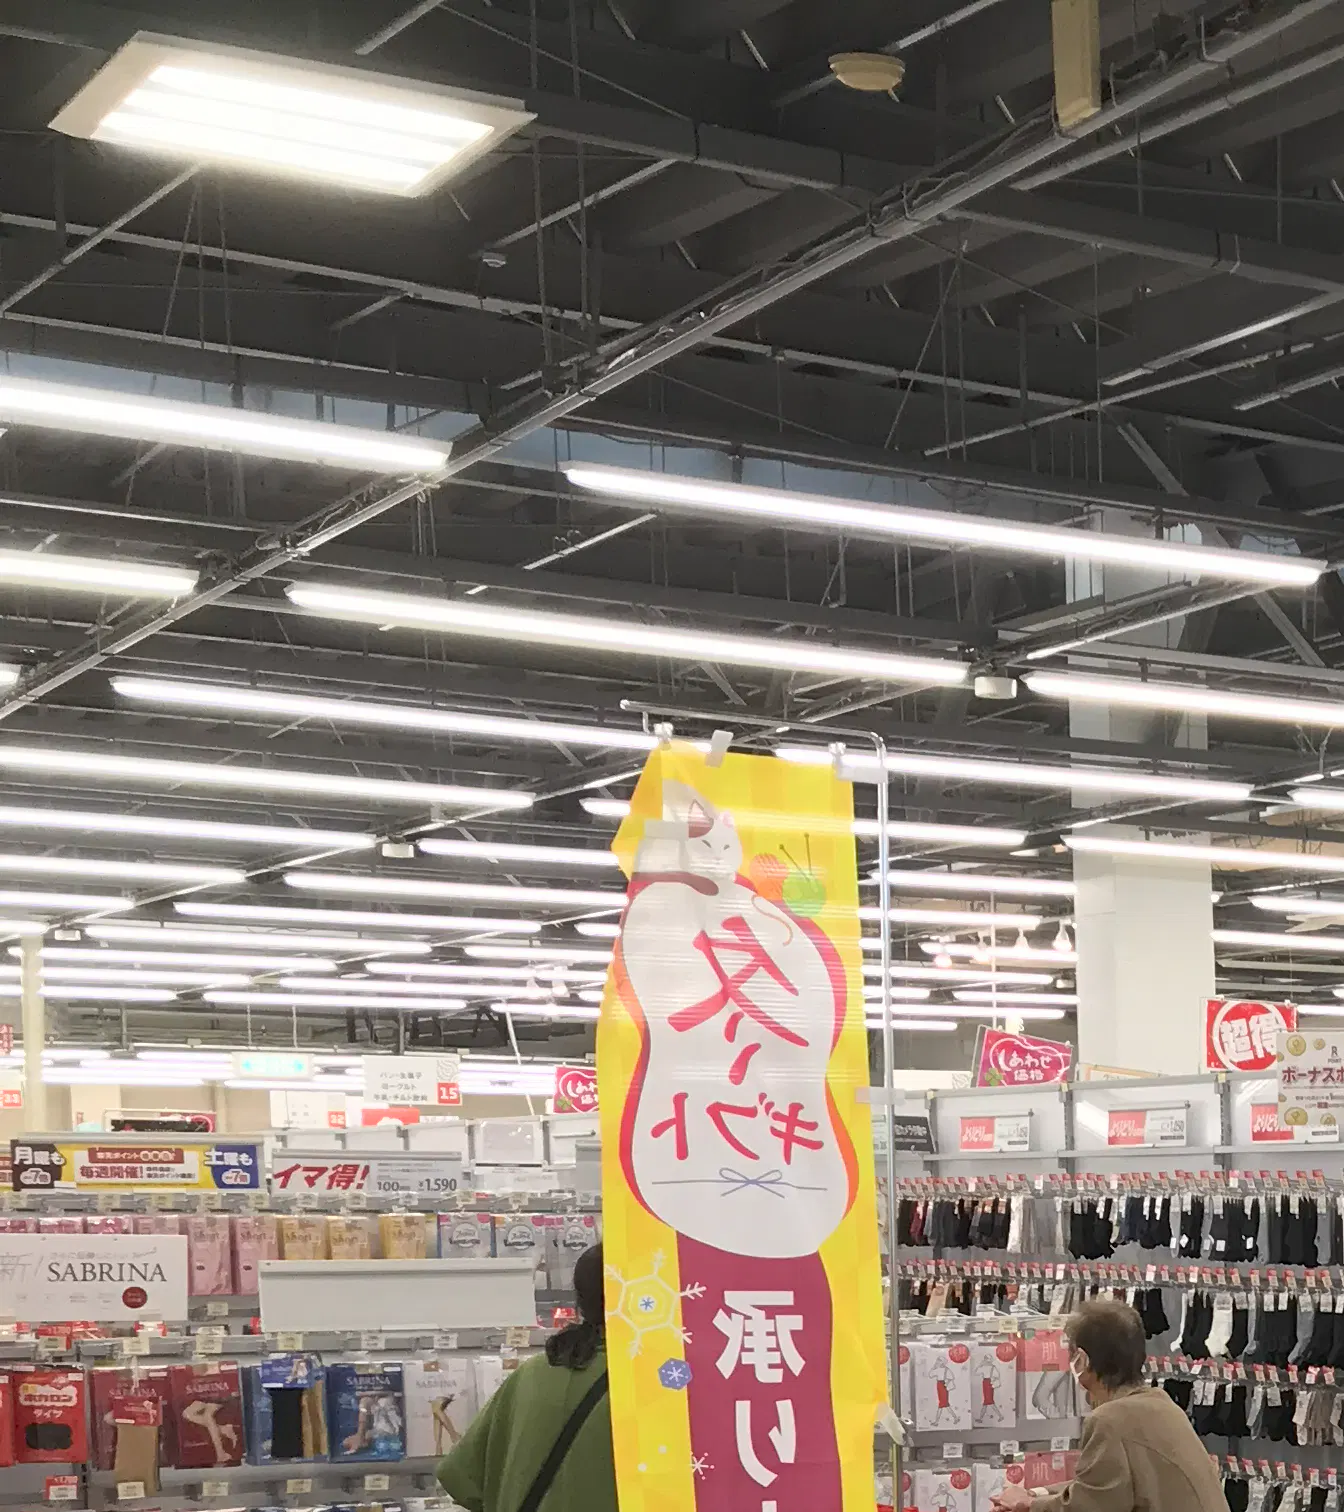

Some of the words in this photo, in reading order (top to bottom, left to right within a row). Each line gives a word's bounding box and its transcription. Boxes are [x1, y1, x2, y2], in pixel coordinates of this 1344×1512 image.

[998, 1049, 1052, 1072] しあわせ
[440, 1087, 458, 1099] 15
[566, 1080, 597, 1098] しあわ
[273, 1163, 370, 1190] イマ得!
[47, 1262, 167, 1283] SABRINA
